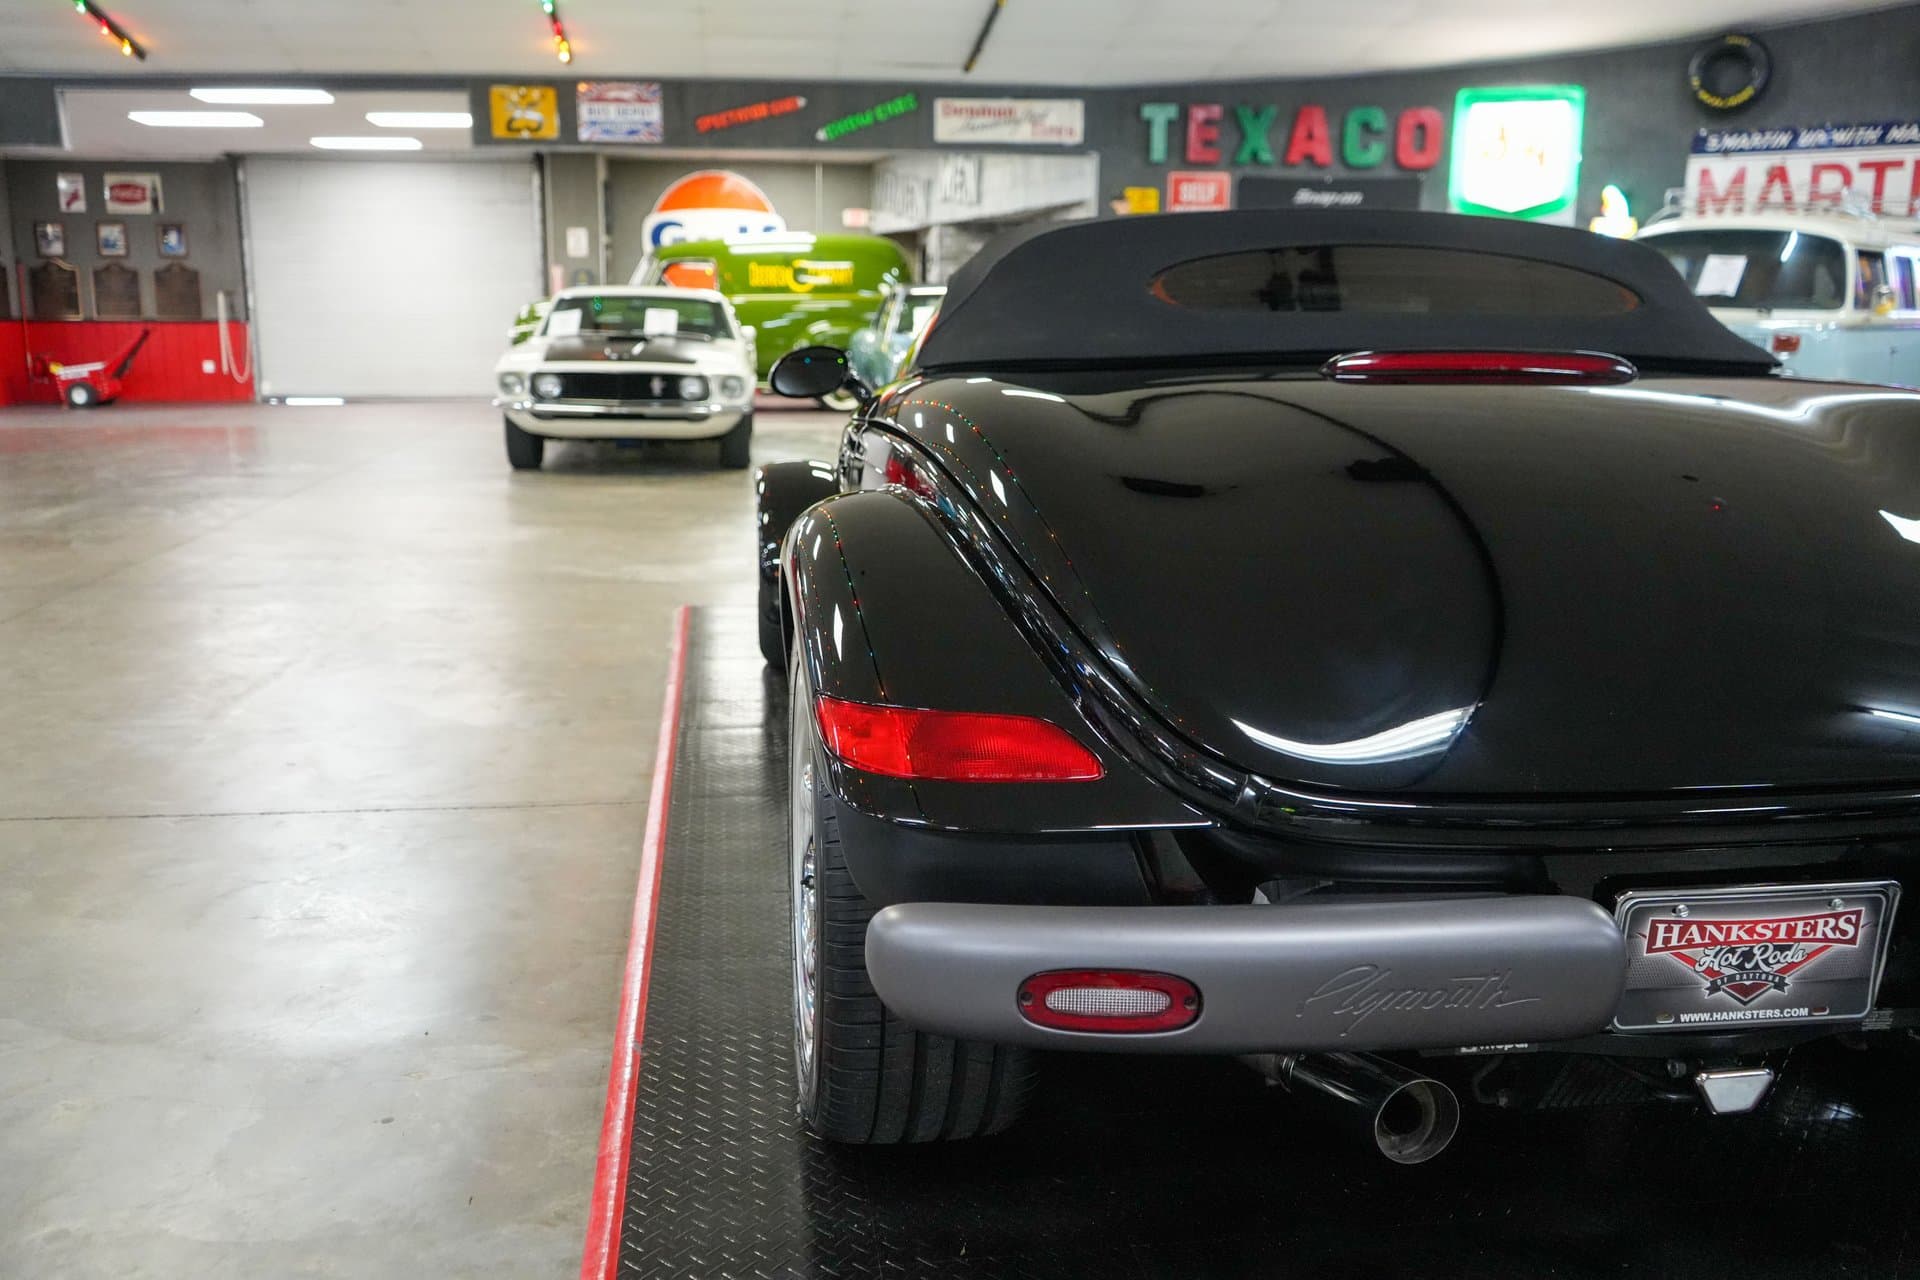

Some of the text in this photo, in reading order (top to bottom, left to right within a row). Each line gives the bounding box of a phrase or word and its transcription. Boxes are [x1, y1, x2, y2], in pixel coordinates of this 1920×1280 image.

[1140, 102, 1444, 169] TEXACO
[1652, 914, 1857, 949] HANKSTERS
[1695, 942, 1808, 971] Hot Rods
[1717, 973, 1780, 986] OF DAYTONA
[1296, 964, 1541, 1037] Plymouth
[1680, 1007, 1809, 1023] WWW.HANKSTERS.COM
